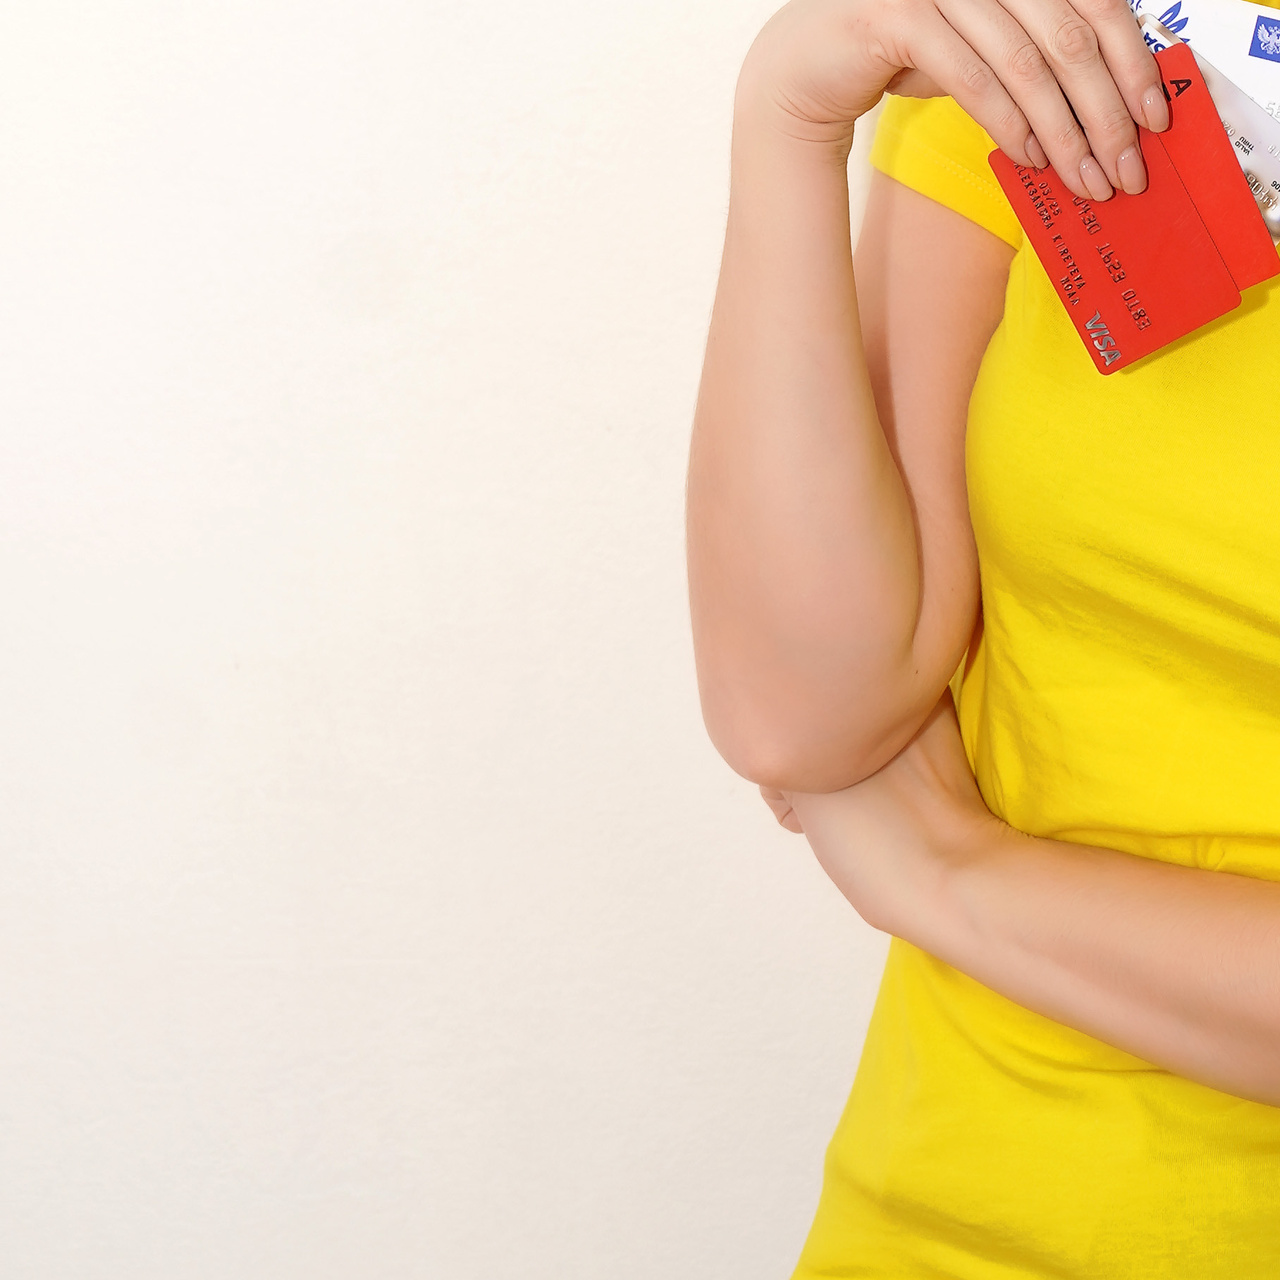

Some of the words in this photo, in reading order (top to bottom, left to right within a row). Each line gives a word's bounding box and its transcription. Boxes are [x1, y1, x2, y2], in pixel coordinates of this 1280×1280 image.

[1234, 140, 1251, 156] VALID
[1239, 136, 1255, 151] THRU
[1096, 242, 1127, 283] 1623
[1121, 288, 1152, 331] 0183
[1085, 309, 1121, 366] VISA
